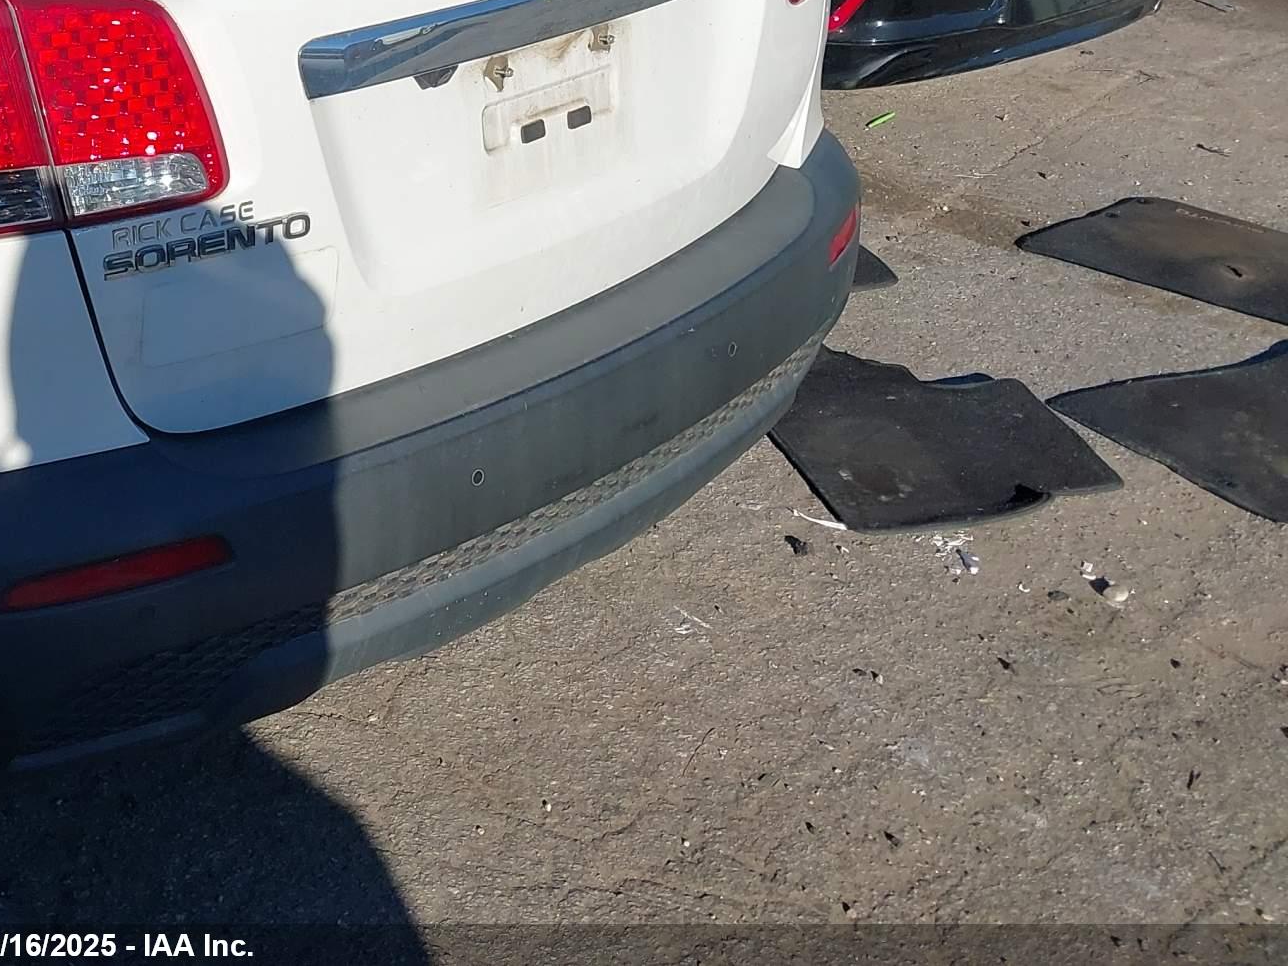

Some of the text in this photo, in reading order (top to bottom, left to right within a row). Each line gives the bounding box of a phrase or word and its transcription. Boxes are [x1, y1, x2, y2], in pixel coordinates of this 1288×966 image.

[103, 212, 311, 281] SORENTO
[112, 201, 254, 249] RICK CASE
